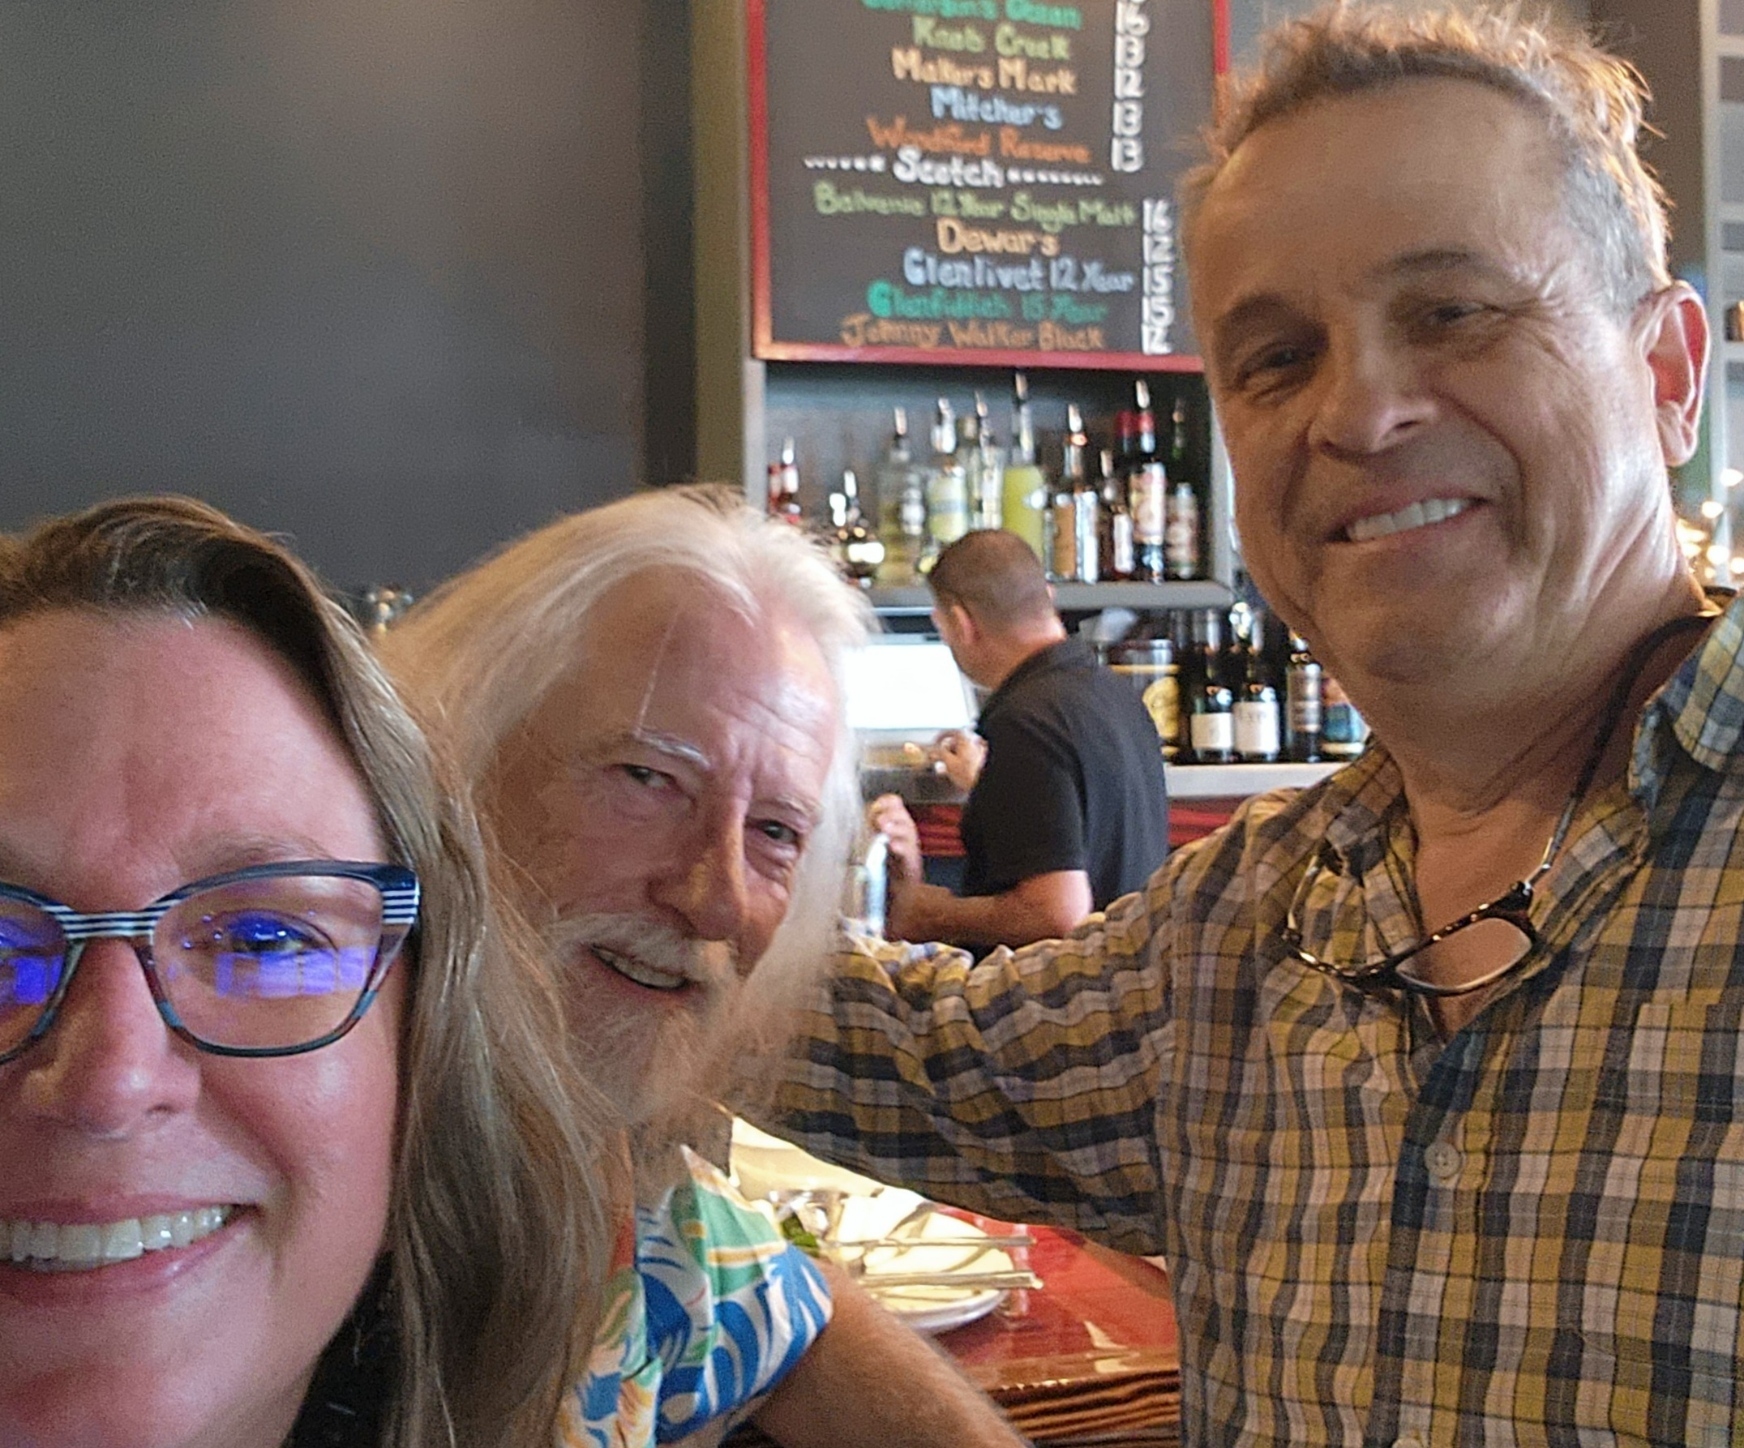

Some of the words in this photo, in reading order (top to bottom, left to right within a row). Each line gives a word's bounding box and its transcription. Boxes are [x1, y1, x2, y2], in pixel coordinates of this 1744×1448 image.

[999, 58, 1076, 94] Mark
[893, 146, 1004, 187] Scotch
[904, 246, 1044, 290] Glenlivet
[1050, 257, 1078, 290] 12
